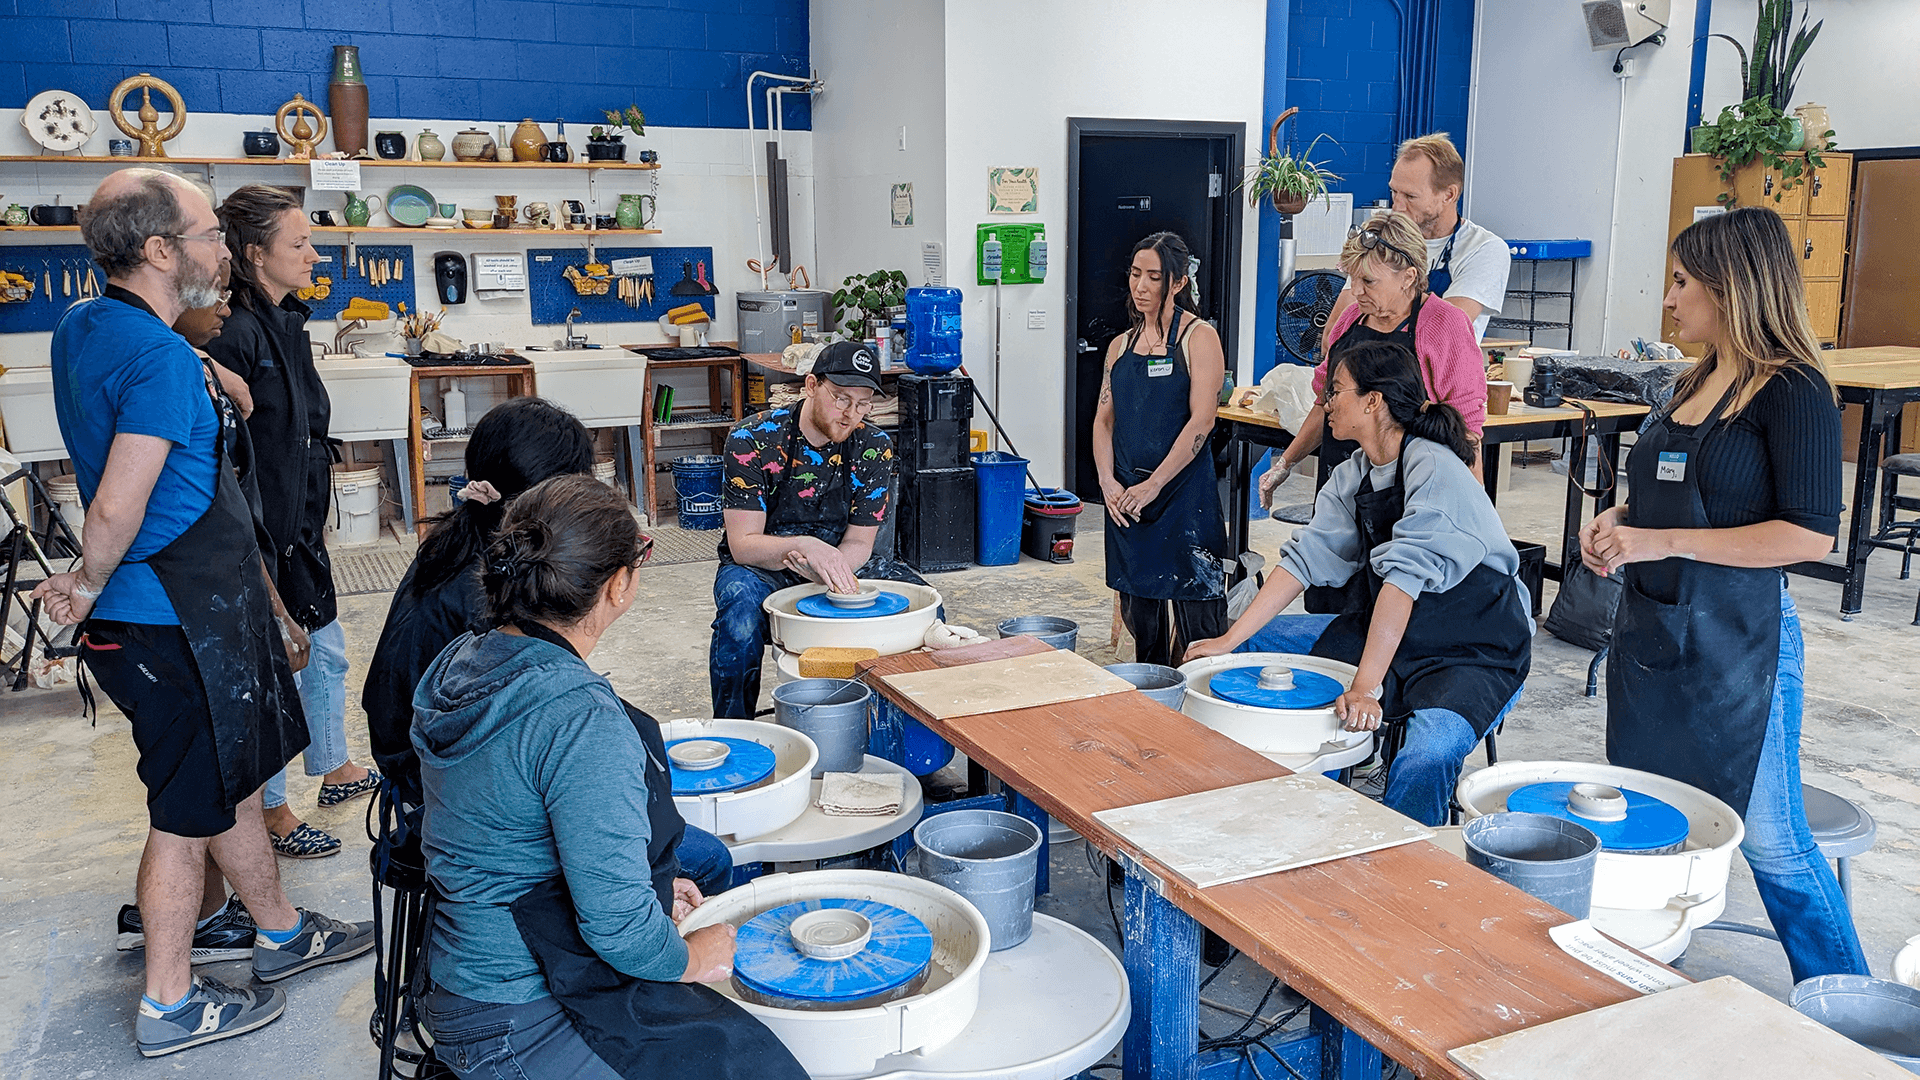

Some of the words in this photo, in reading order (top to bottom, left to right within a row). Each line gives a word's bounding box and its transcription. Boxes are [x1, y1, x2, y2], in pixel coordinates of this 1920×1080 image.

[1565, 943, 1581, 955] put
[1573, 935, 1594, 950] each
[1581, 953, 1593, 961] be
[1593, 949, 1616, 961] after
[1593, 960, 1616, 973] must
[1616, 959, 1642, 974] wheel
[1633, 959, 1650, 968] use
[1616, 971, 1639, 985] Pans
[1643, 973, 1665, 986] onto
